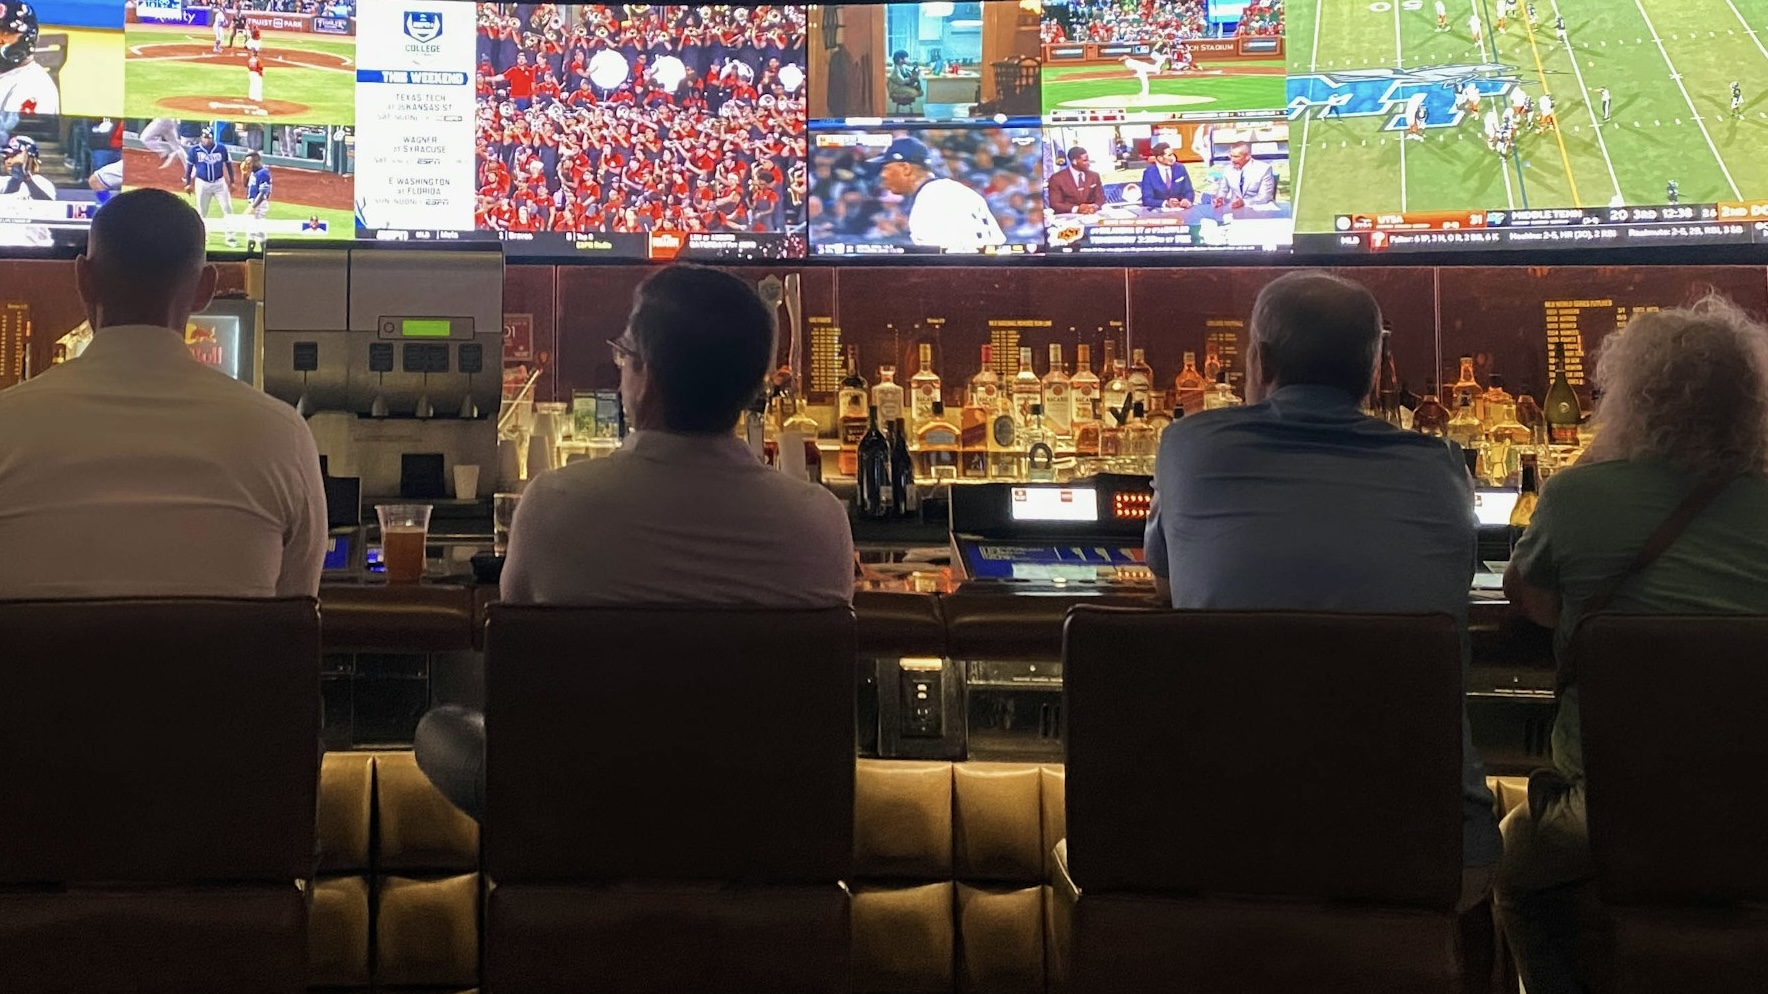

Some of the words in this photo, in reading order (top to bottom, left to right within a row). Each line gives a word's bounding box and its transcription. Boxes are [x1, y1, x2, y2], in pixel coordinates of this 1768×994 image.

[284, 18, 303, 28] PARK
[404, 44, 440, 53] COLLEGE
[382, 71, 408, 84] THIS
[410, 72, 464, 84] WEEKEND
[396, 93, 422, 102] TEXAS
[426, 94, 446, 102] TECH
[406, 104, 440, 112] KANSAS
[403, 146, 446, 154] SYRACUSE
[1376, 215, 1404, 224] UTSA
[1512, 210, 1552, 220] MIDDLE
[1554, 209, 1582, 219] TENN
[1610, 210, 1628, 220] 20
